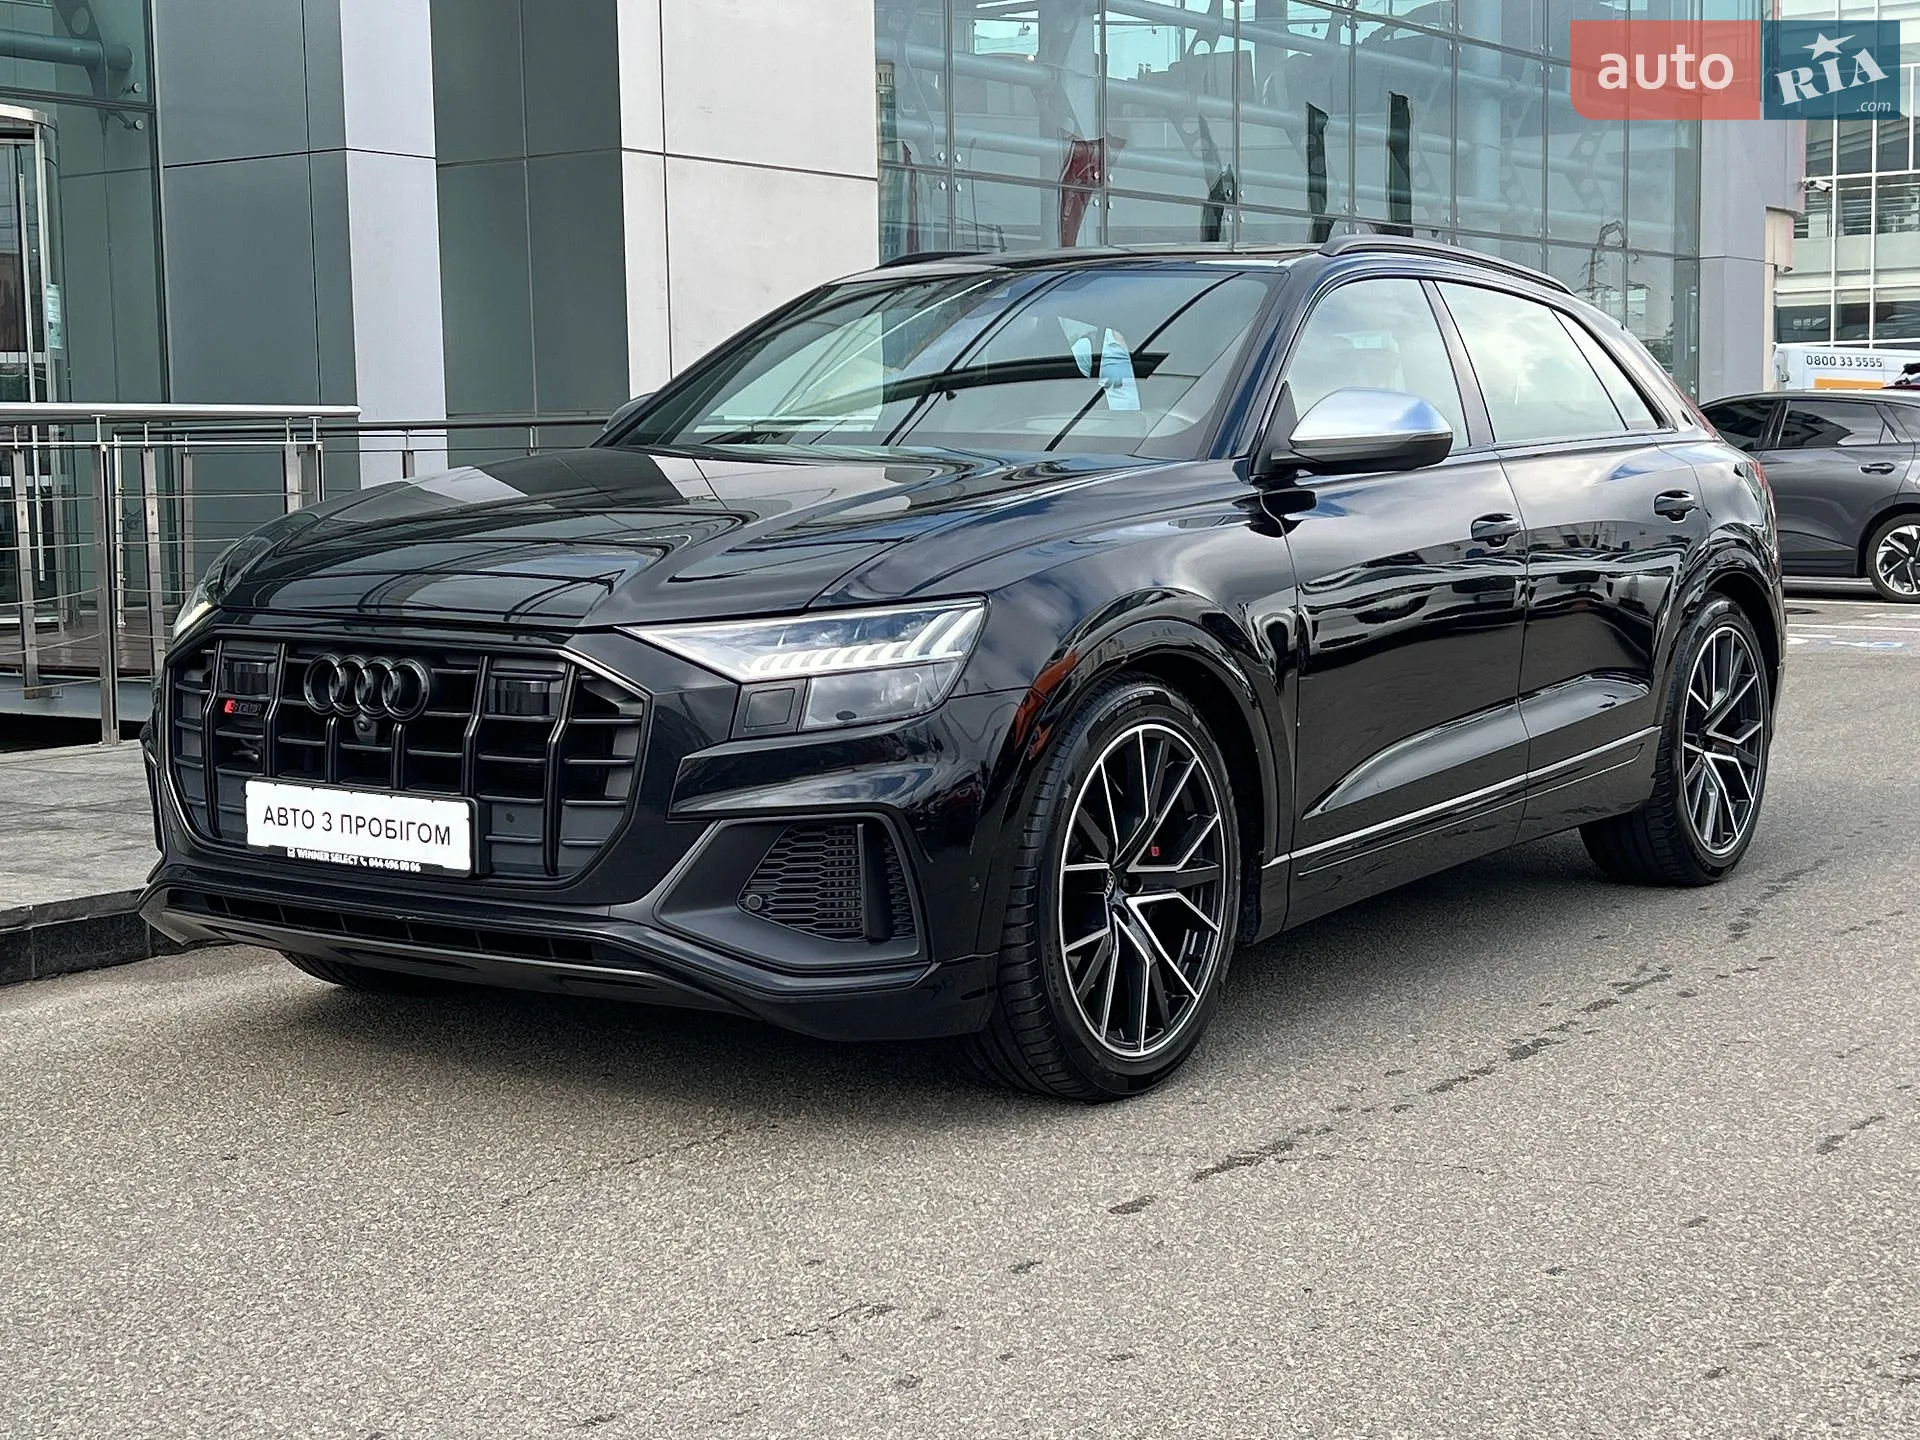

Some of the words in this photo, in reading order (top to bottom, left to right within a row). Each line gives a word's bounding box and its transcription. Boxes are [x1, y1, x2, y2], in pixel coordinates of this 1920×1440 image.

[1806, 355, 1837, 366] 0800
[1839, 356, 1853, 367] 33
[1855, 357, 1883, 368] 5555
[263, 805, 315, 830] АВТО
[340, 814, 451, 846] ПРОБІГОМ
[296, 848, 329, 862] WINNER
[330, 853, 359, 865] SELECT
